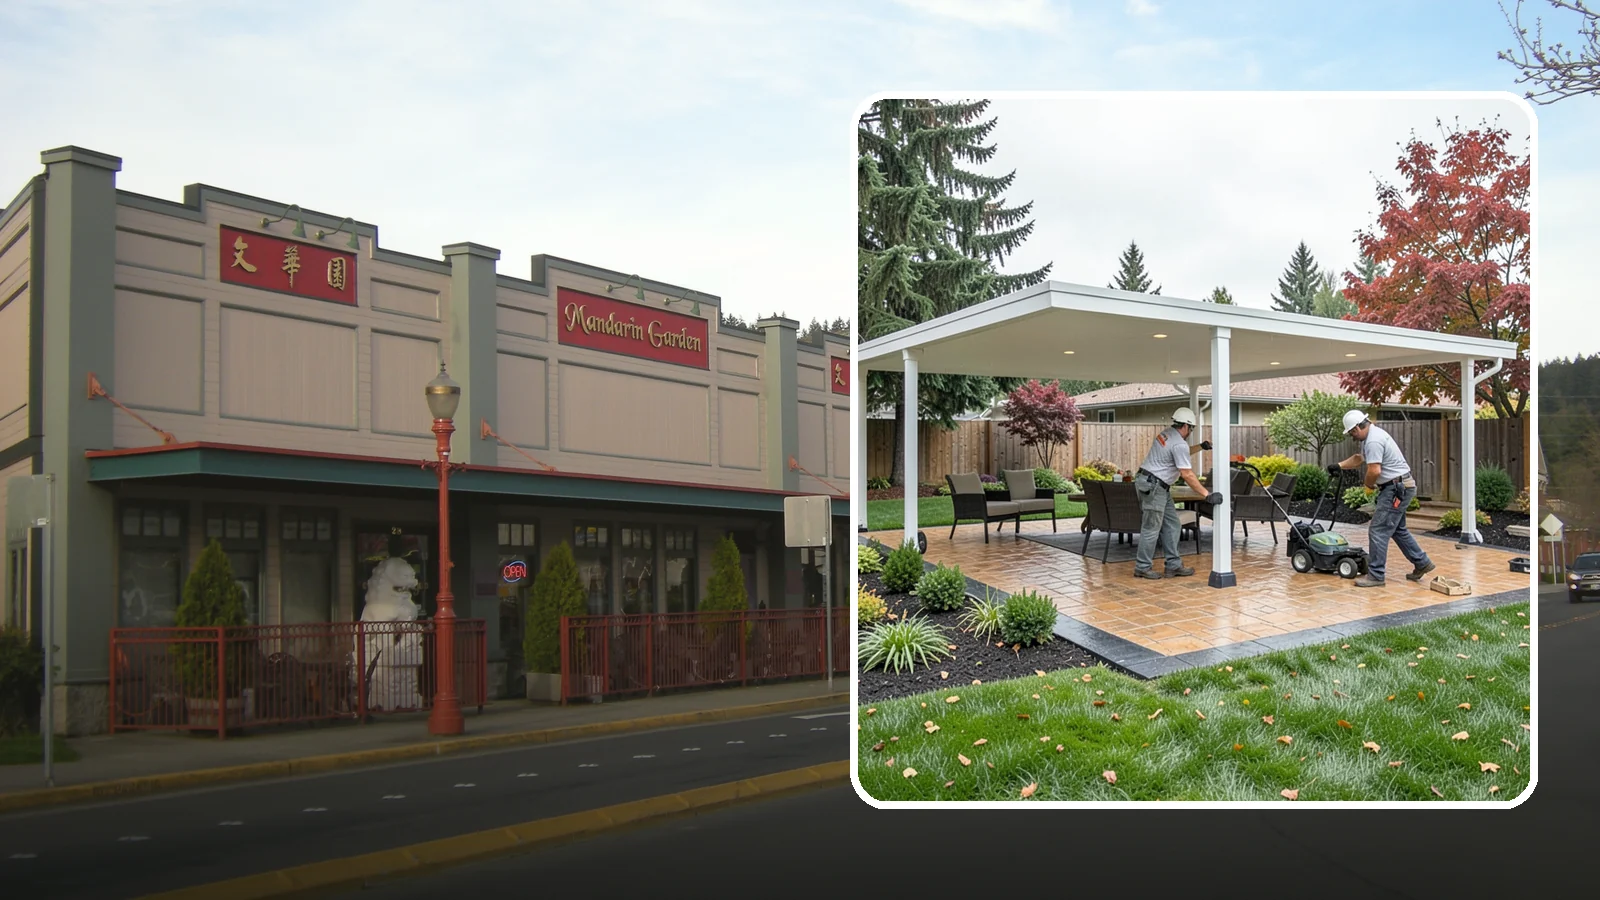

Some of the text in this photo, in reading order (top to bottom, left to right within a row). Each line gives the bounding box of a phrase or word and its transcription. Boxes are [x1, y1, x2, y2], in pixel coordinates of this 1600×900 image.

[231, 235, 346, 291] 文華園
[564, 302, 702, 352] Mandarin Garden
[503, 565, 527, 578] OPEN
